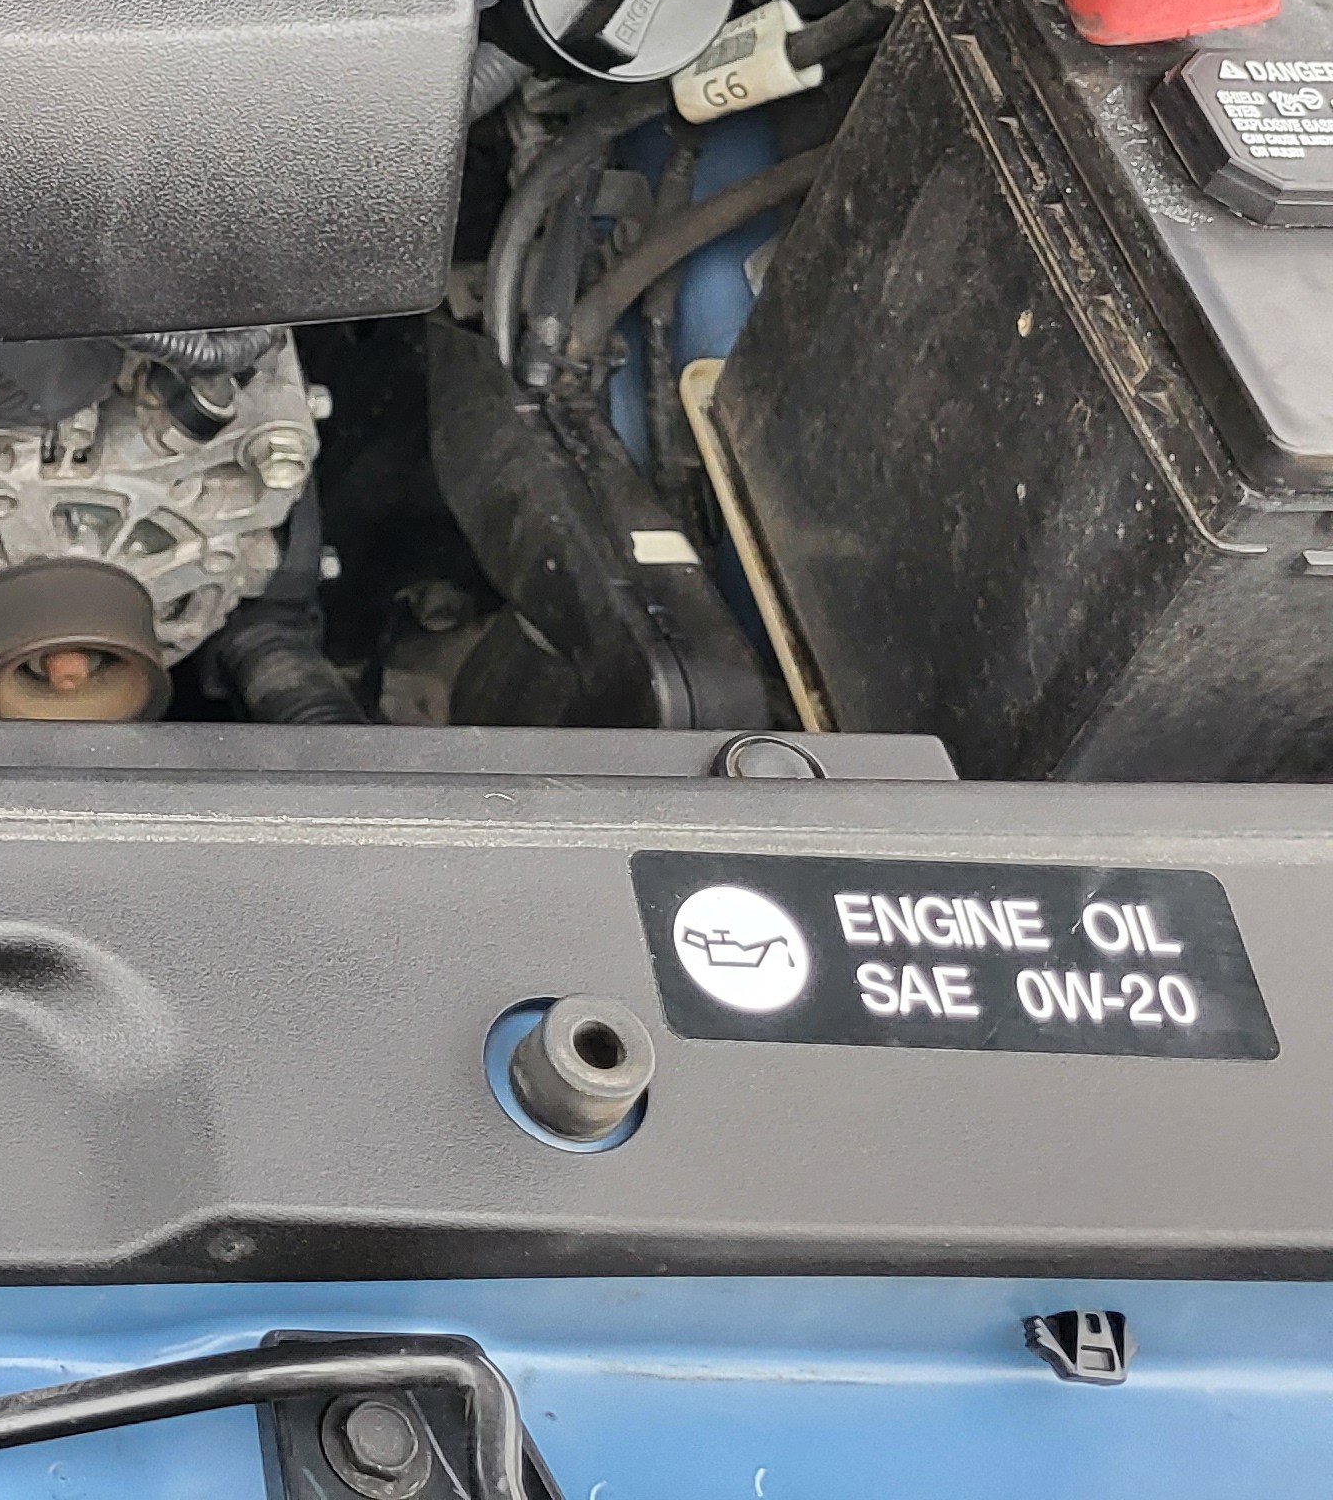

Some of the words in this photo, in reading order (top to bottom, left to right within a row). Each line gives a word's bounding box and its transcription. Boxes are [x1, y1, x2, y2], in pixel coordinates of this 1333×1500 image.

[702, 71, 749, 108] G6
[1216, 90, 1266, 106] SHIELD
[834, 893, 1052, 951] ENGINE
[1081, 901, 1183, 955] OIL
[855, 961, 981, 1019] SAE
[1015, 968, 1198, 1026] 0W-20
